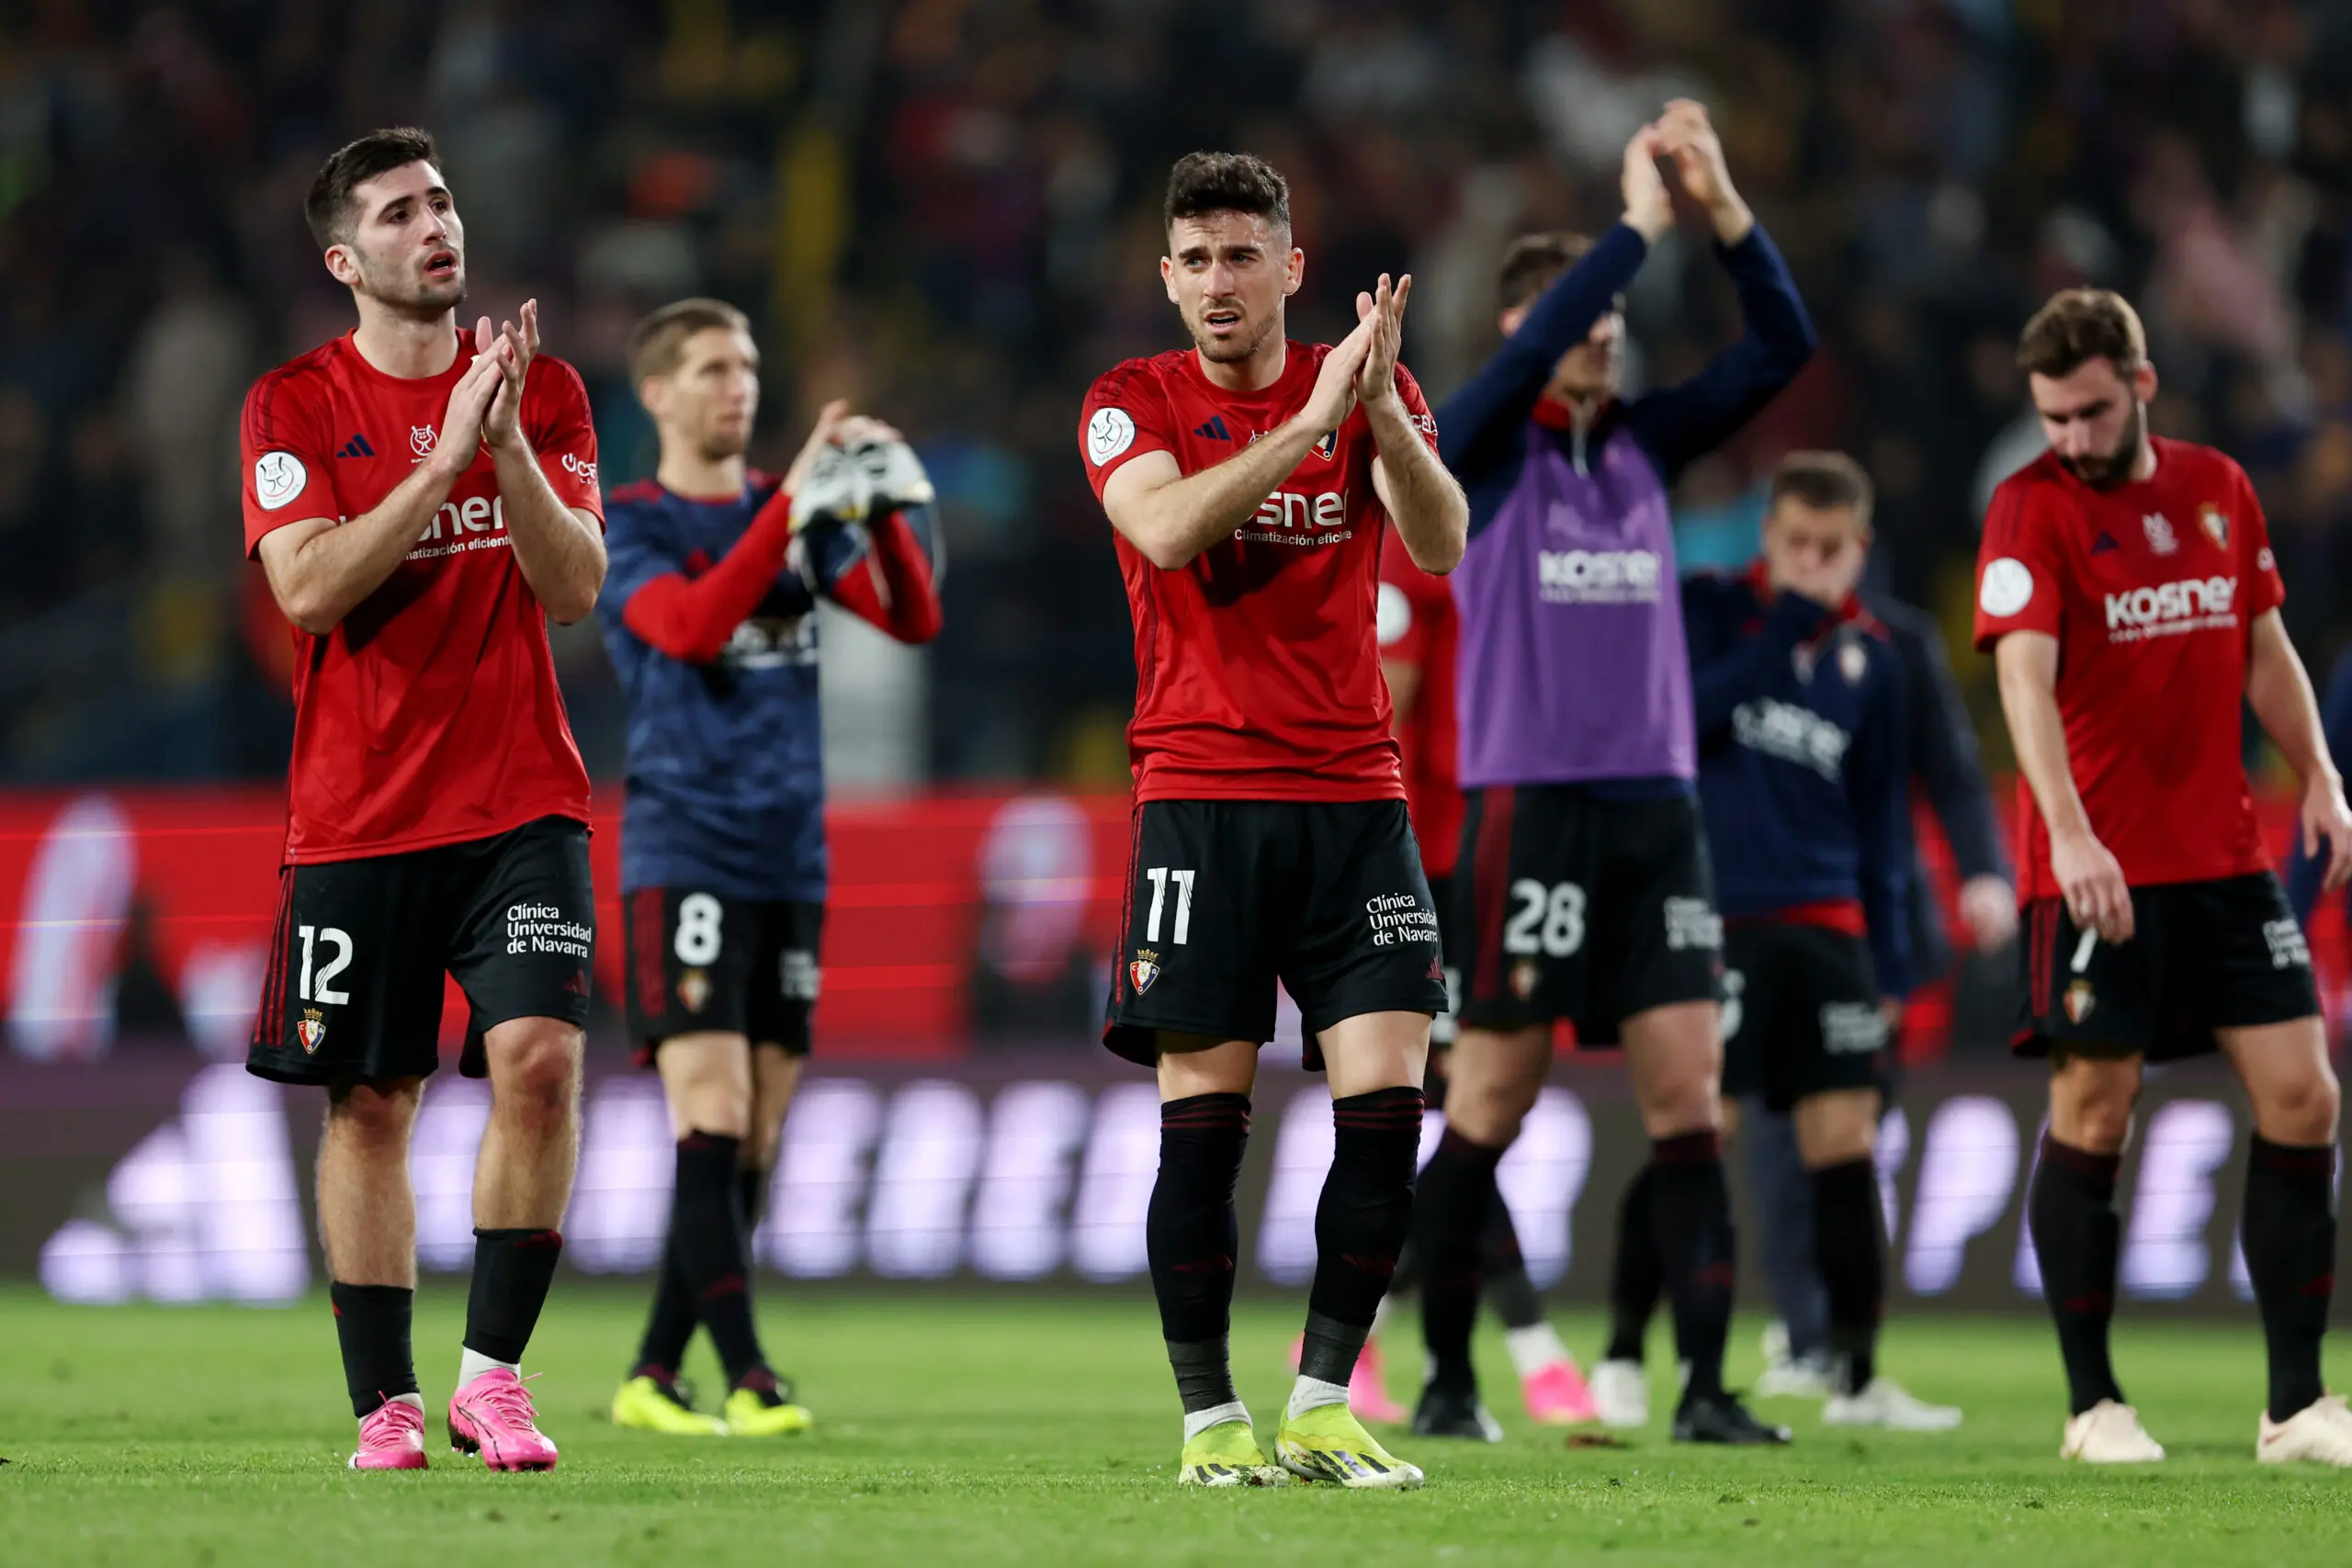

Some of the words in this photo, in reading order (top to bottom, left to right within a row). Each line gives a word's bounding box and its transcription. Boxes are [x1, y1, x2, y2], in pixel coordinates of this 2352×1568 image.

[1234, 528, 1315, 547] Climatización
[506, 902, 560, 921] Clínica
[1147, 866, 1195, 945] 11
[1366, 892, 1416, 913] Clínica
[673, 893, 723, 965] 8
[1505, 879, 1587, 957] 28
[506, 919, 592, 942] Universidad
[1374, 930, 1395, 946] de
[506, 938, 527, 954] de
[532, 935, 588, 958] Navarra
[298, 925, 354, 1005] 12
